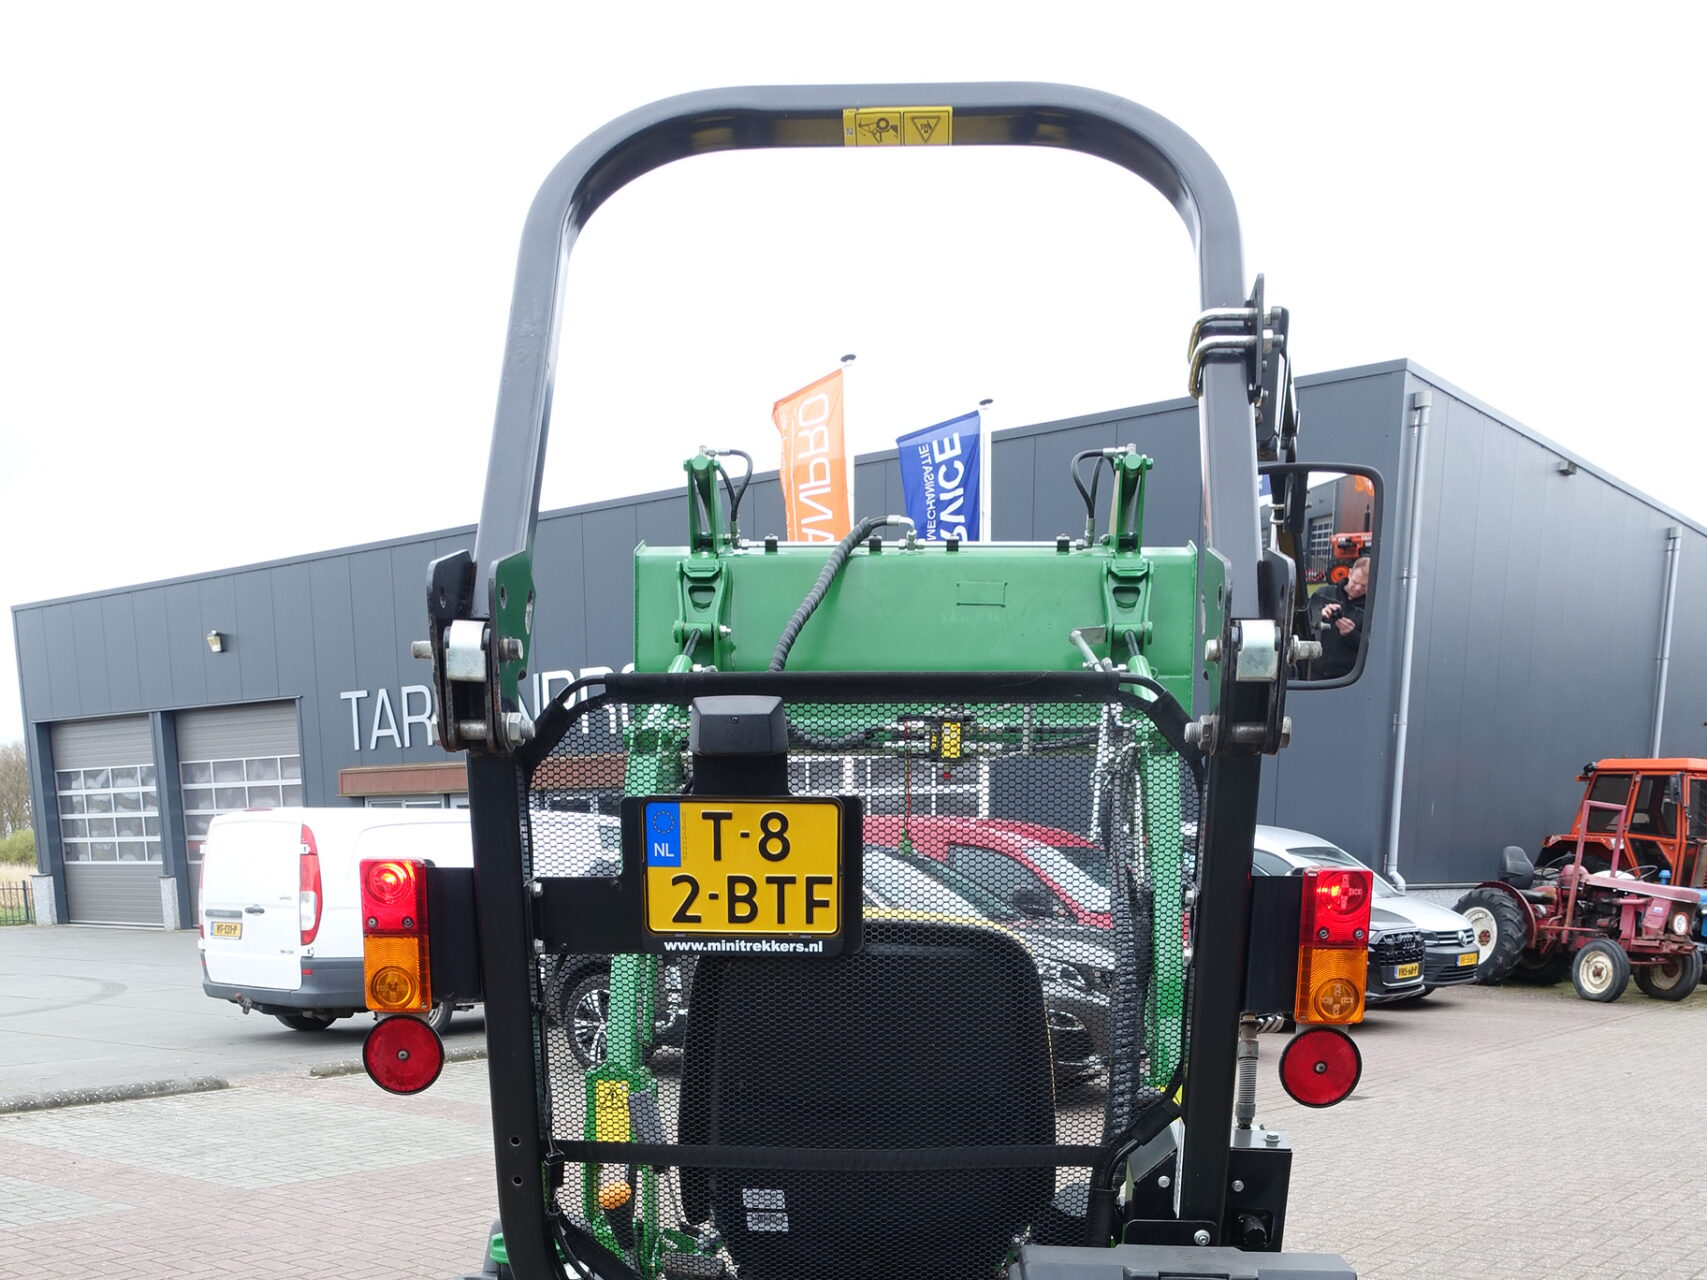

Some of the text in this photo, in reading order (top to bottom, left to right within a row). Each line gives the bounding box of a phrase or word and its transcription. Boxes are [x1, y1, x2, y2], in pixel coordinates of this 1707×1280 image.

[653, 842, 674, 857] NL
[702, 811, 790, 862] T-8
[671, 874, 833, 925] 2-BTF
[663, 939, 824, 953] www.minitrekkers.nl
